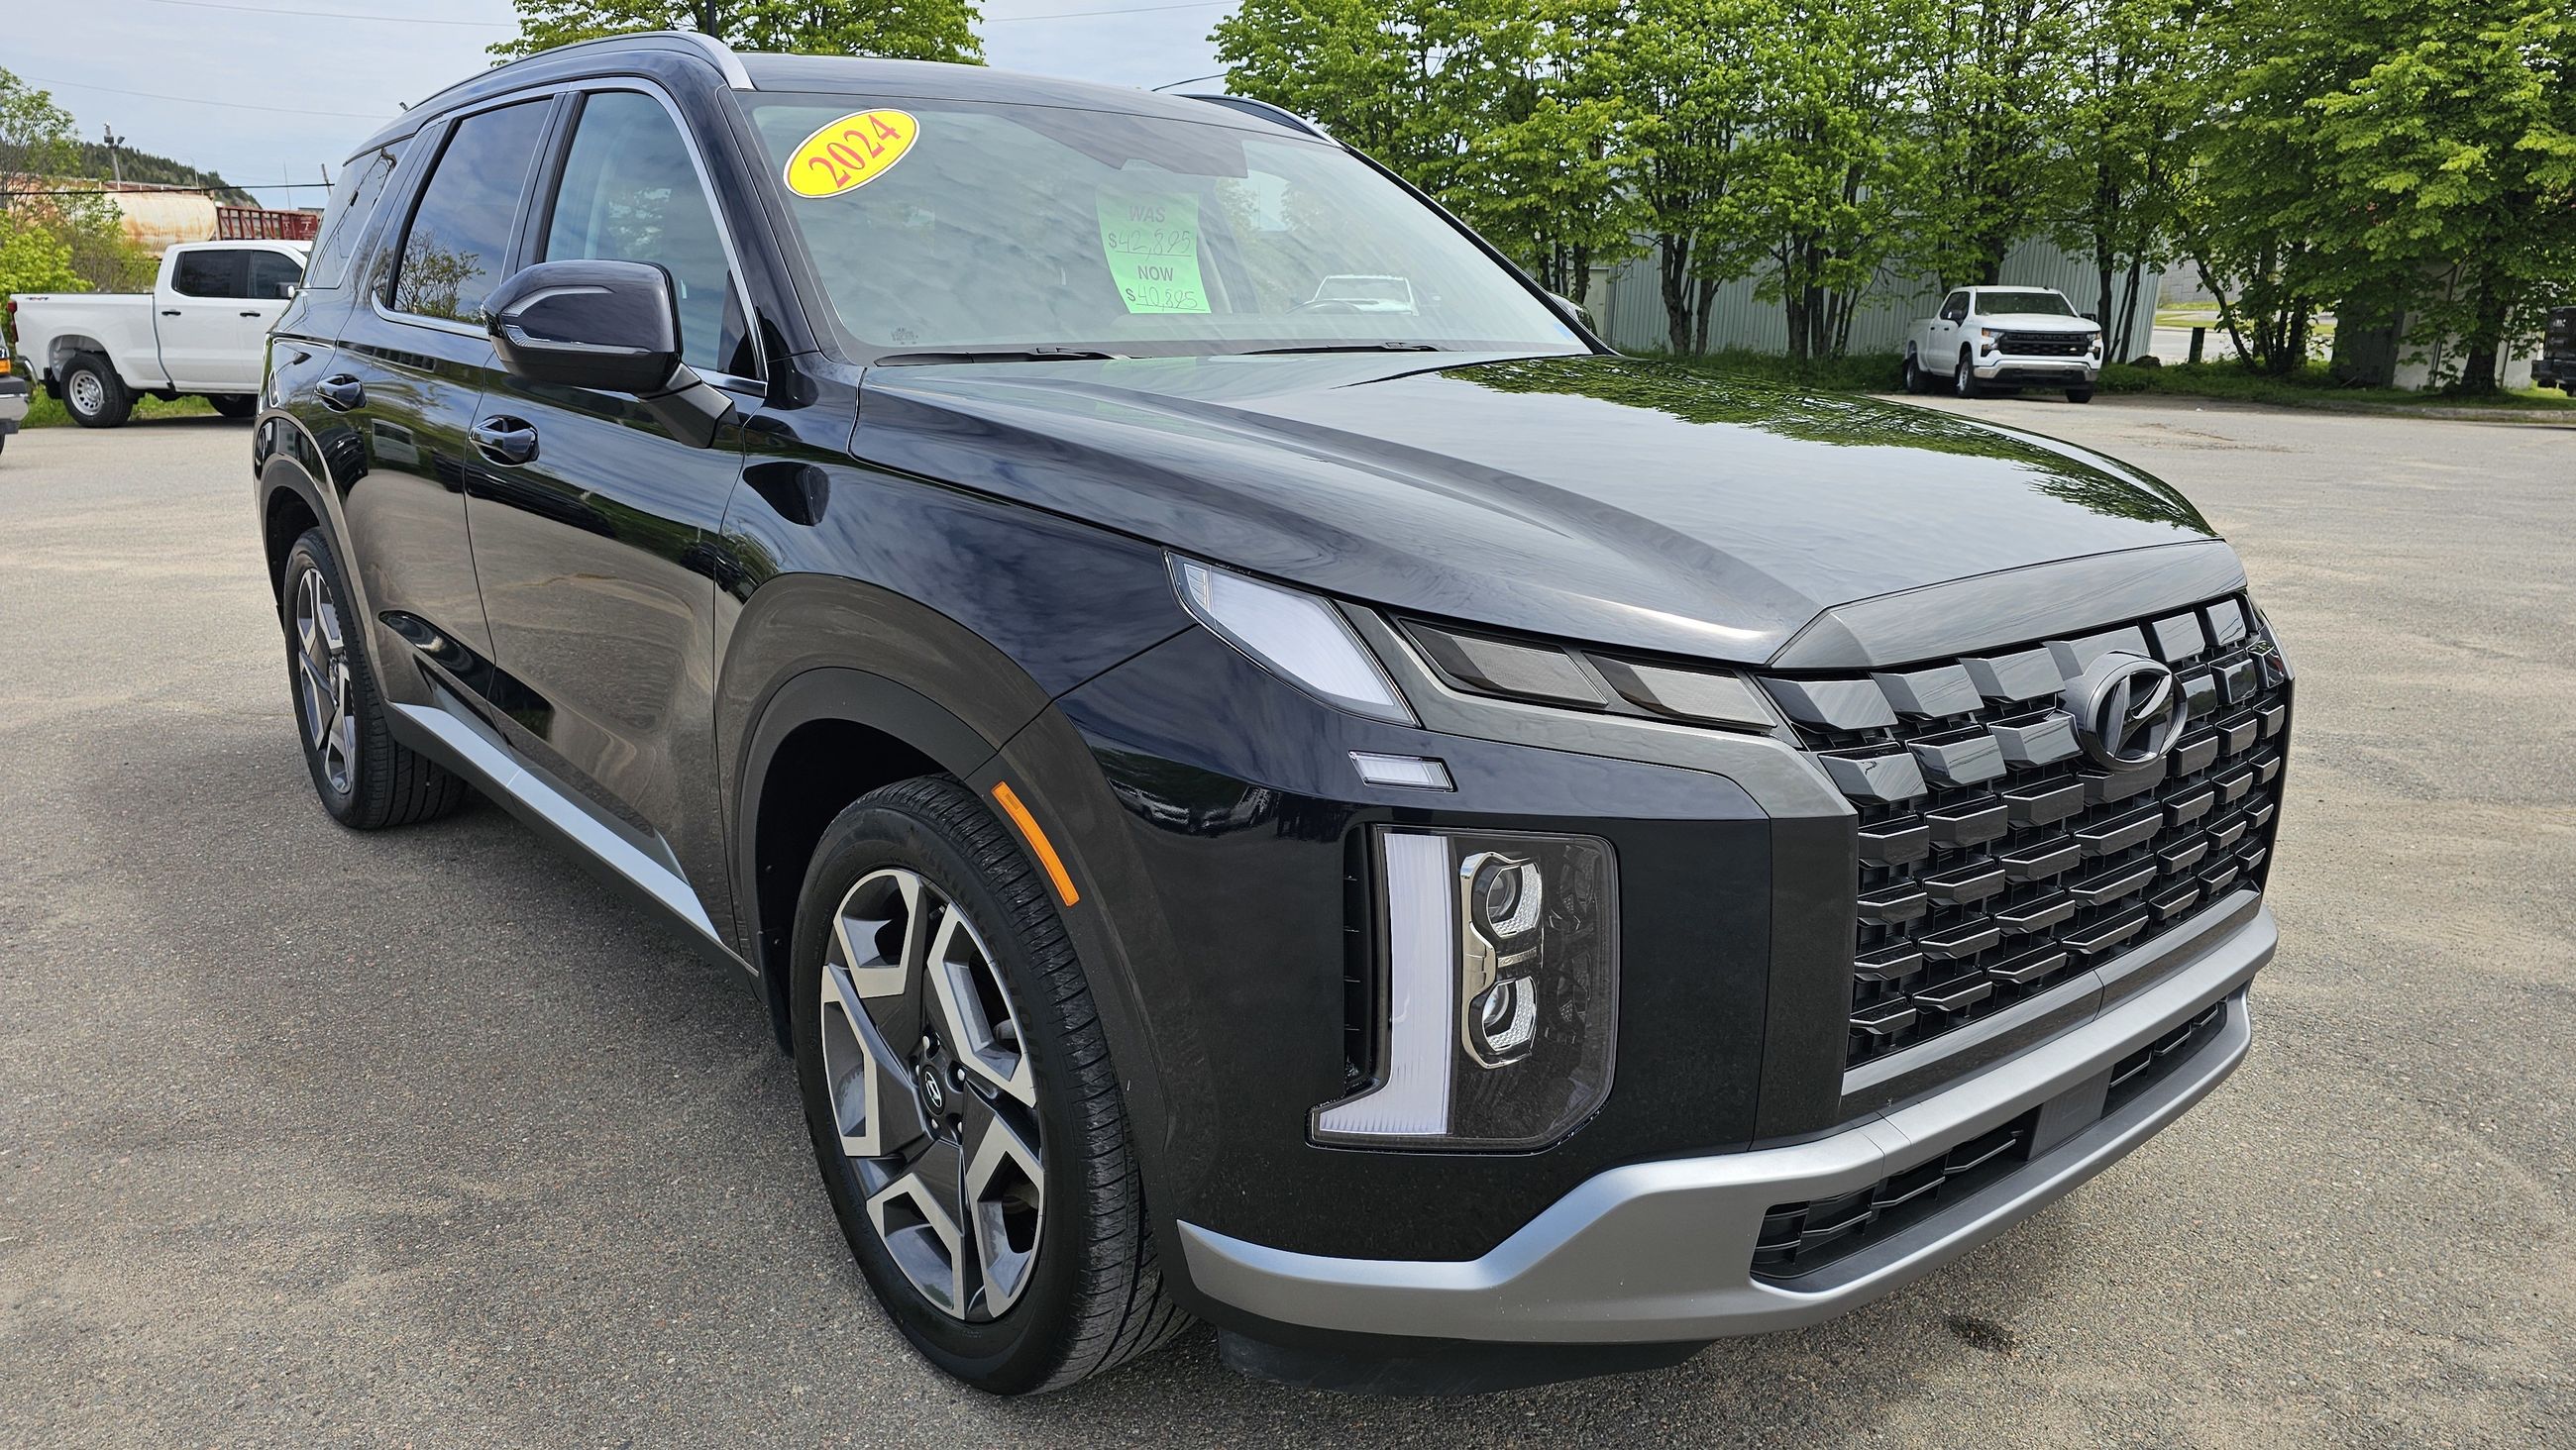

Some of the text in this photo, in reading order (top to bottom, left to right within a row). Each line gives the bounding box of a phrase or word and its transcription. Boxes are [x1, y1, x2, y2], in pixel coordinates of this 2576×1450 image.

[808, 114, 902, 188] 2024
[1128, 205, 1166, 223] WAS
[1137, 264, 1174, 282] NOW
